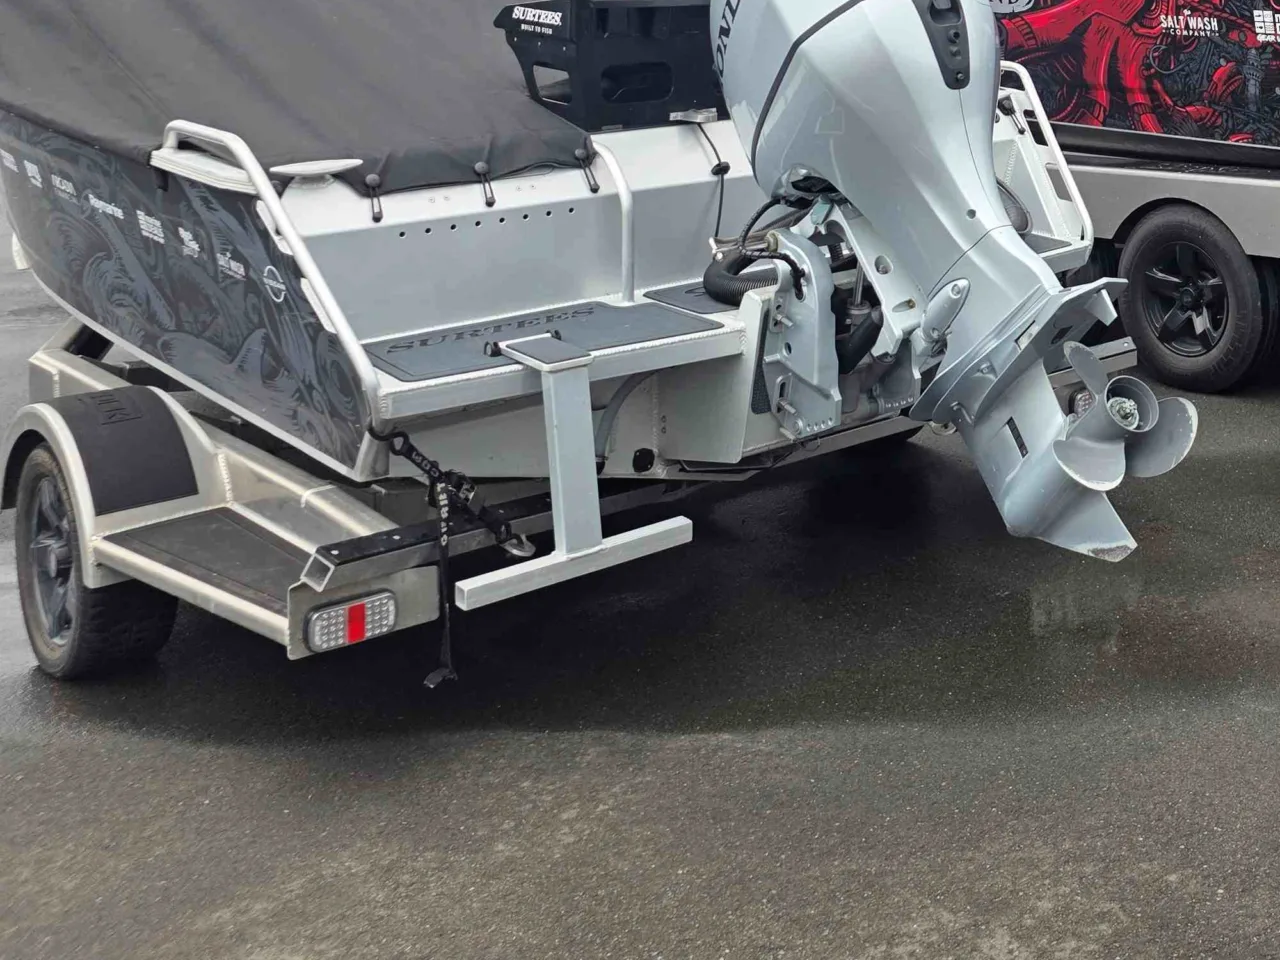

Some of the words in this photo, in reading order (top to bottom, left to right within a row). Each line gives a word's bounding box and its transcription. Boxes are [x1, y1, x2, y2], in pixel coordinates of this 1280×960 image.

[512, 6, 562, 26] SURTEES
[1160, 15, 1185, 29] SALT
[1187, 16, 1218, 31] WASH
[1170, 28, 1210, 38] COMPANY
[386, 307, 595, 356] SURTEES
